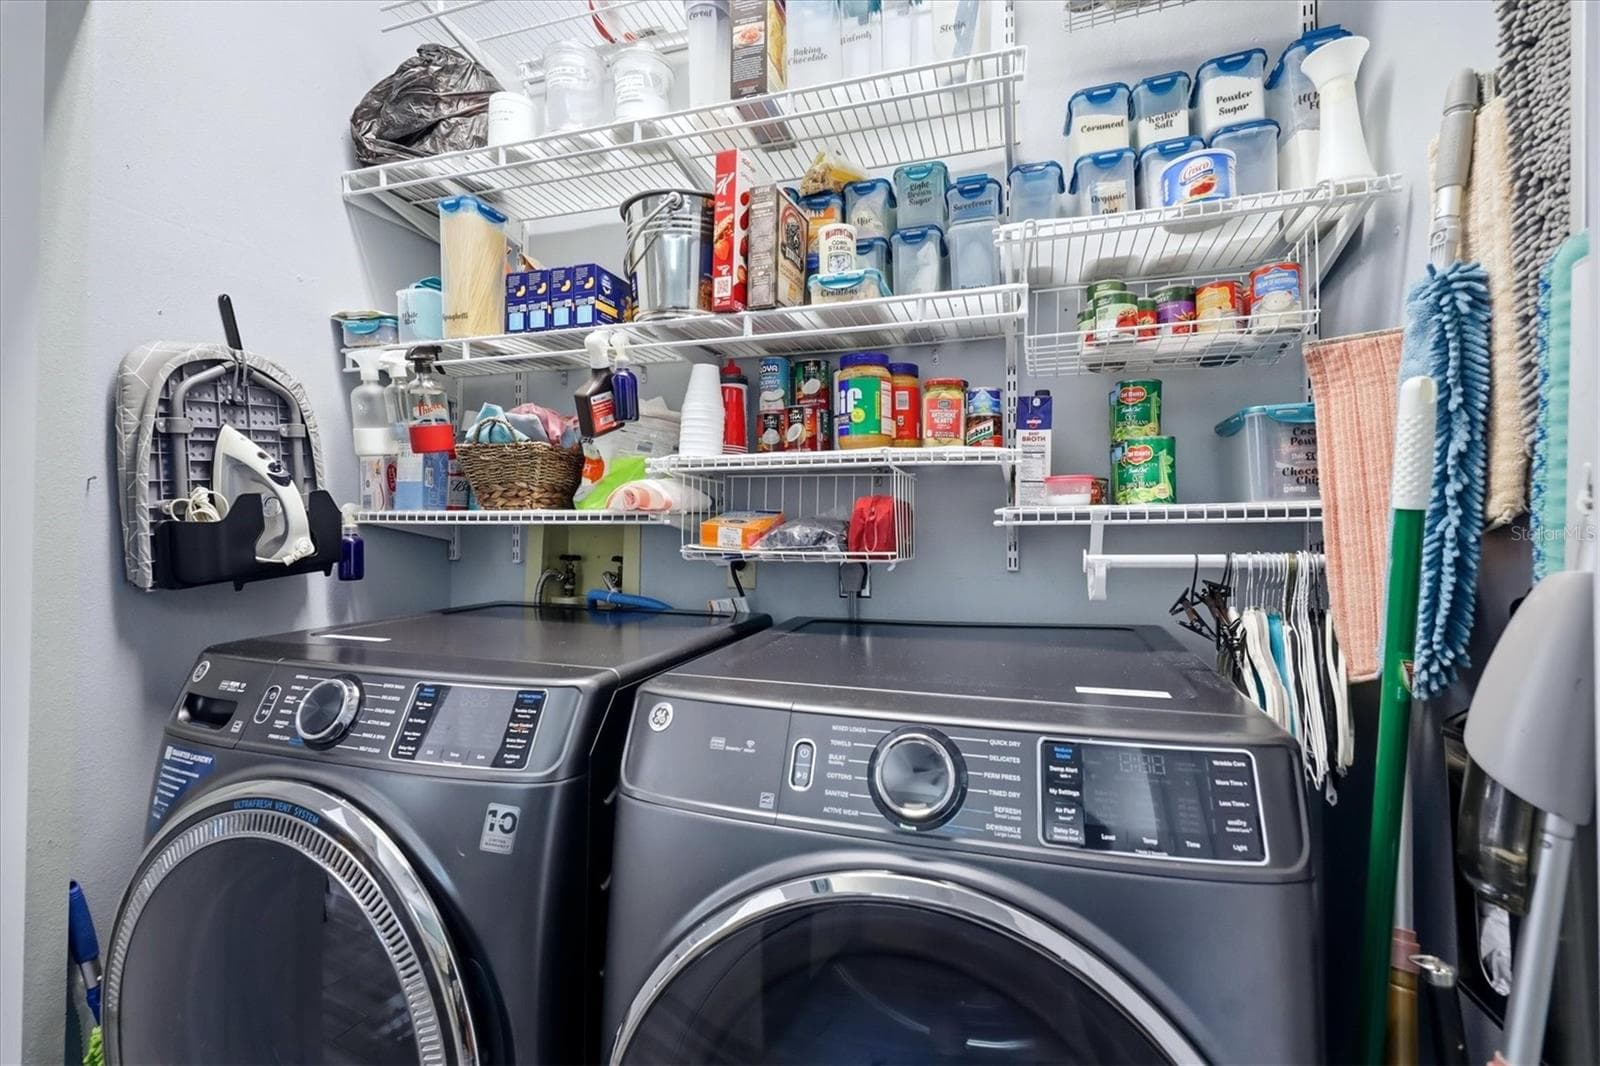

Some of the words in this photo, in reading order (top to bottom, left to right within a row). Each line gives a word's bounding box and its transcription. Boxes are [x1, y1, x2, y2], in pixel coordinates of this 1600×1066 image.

[793, 47, 822, 57] Baking
[788, 54, 828, 66] Chocolate
[1216, 90, 1253, 106] Powder
[1218, 102, 1249, 117] Sugar
[1145, 110, 1180, 124] Kosher
[1080, 119, 1124, 133] Cornmeal
[1154, 119, 1173, 131] Salt
[1182, 160, 1210, 180] Crisco
[908, 196, 932, 208] Sugar
[1091, 192, 1127, 204] Organic
[953, 199, 993, 211] Sweetener
[760, 364, 778, 374] OYA
[840, 387, 863, 415] if
[1292, 427, 1317, 436] Coc
[1290, 437, 1317, 446] Pow
[1306, 452, 1317, 461] &
[1282, 467, 1319, 476] Choco
[1296, 476, 1319, 487] Chi
[849, 726, 866, 734] LOADS
[830, 739, 851, 747] TOWELS
[989, 738, 1008, 747] QUICK
[1008, 740, 1021, 748] DRY
[989, 754, 1021, 764] DELICATES
[826, 772, 852, 781] COTTONS
[983, 772, 1001, 780] PERM
[1001, 773, 1021, 782] PRESS
[824, 789, 849, 798] SANITIZE
[988, 789, 1007, 798] TIMED
[1008, 790, 1021, 799] DRY
[1058, 788, 1080, 797] Settings
[1231, 800, 1245, 808] Time
[233, 798, 273, 809] ULTRAFRESH
[275, 801, 292, 812] VENT
[293, 806, 320, 825] SYSTEM
[823, 806, 842, 815] ACTIVE
[843, 808, 859, 816] WEAR
[993, 805, 1022, 815] REFRESH
[488, 809, 518, 835] 10
[986, 823, 1021, 834] DEWRINKLE
[1233, 844, 1248, 852] Light
